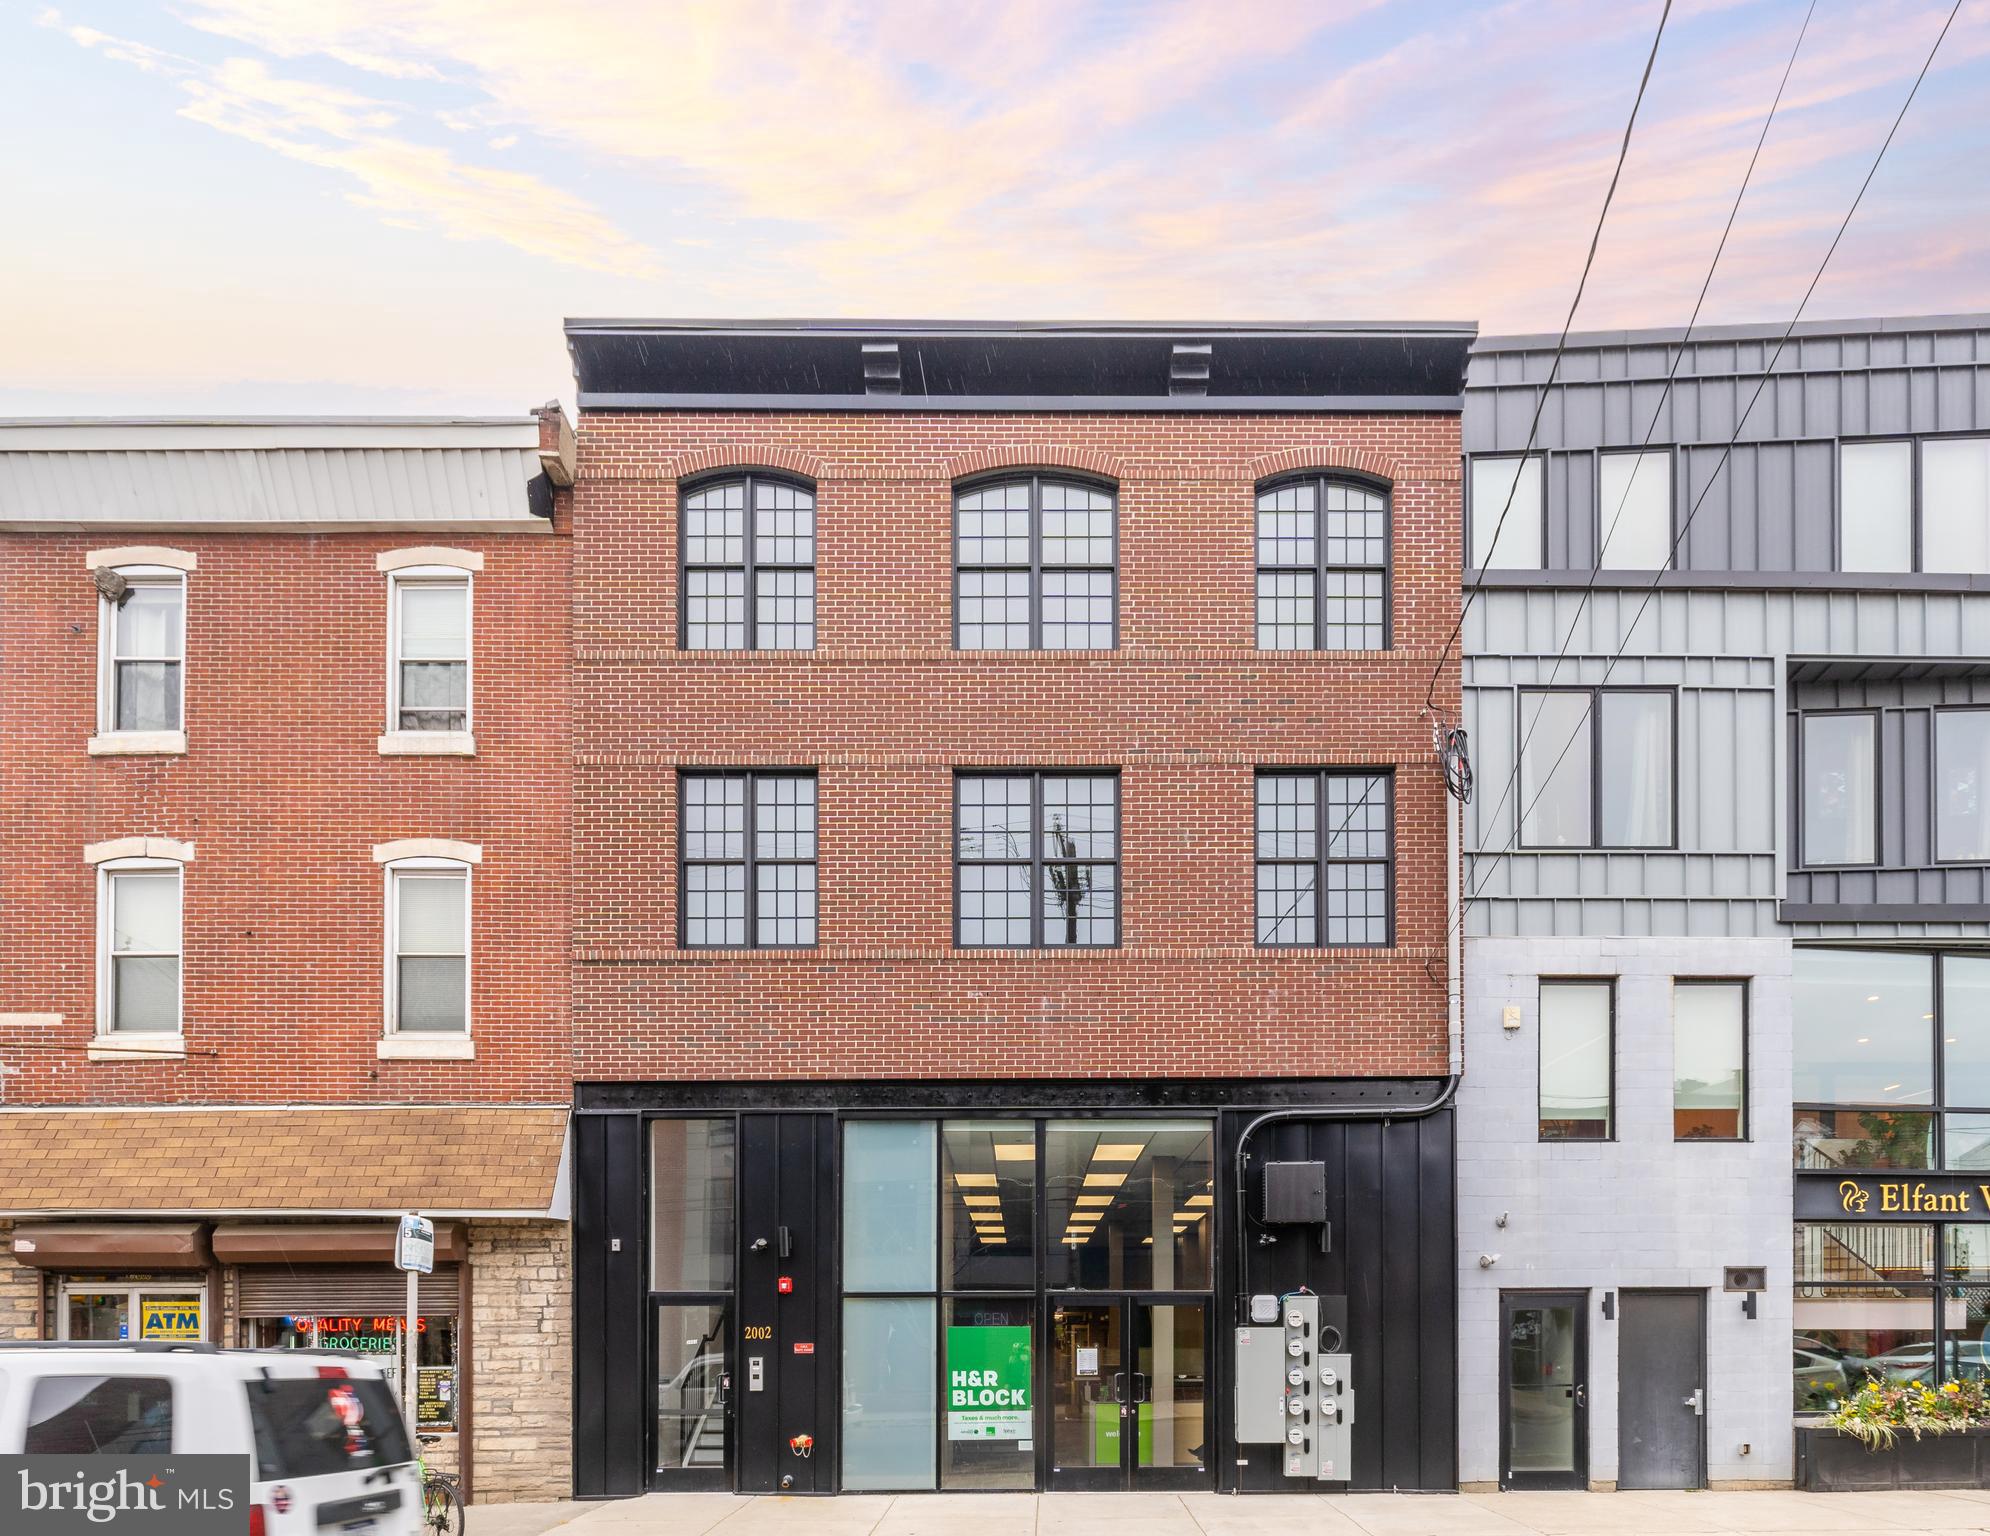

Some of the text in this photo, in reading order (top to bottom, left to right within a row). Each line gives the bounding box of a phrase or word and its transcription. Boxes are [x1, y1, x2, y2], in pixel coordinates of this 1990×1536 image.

[1880, 1183, 1970, 1212] Elfant
[145, 1312, 199, 1329] ATM
[974, 1313, 1009, 1325] OPEN
[744, 1326, 772, 1339] 2002
[952, 1370, 998, 1387] H&R
[952, 1389, 1026, 1406] BLOCK
